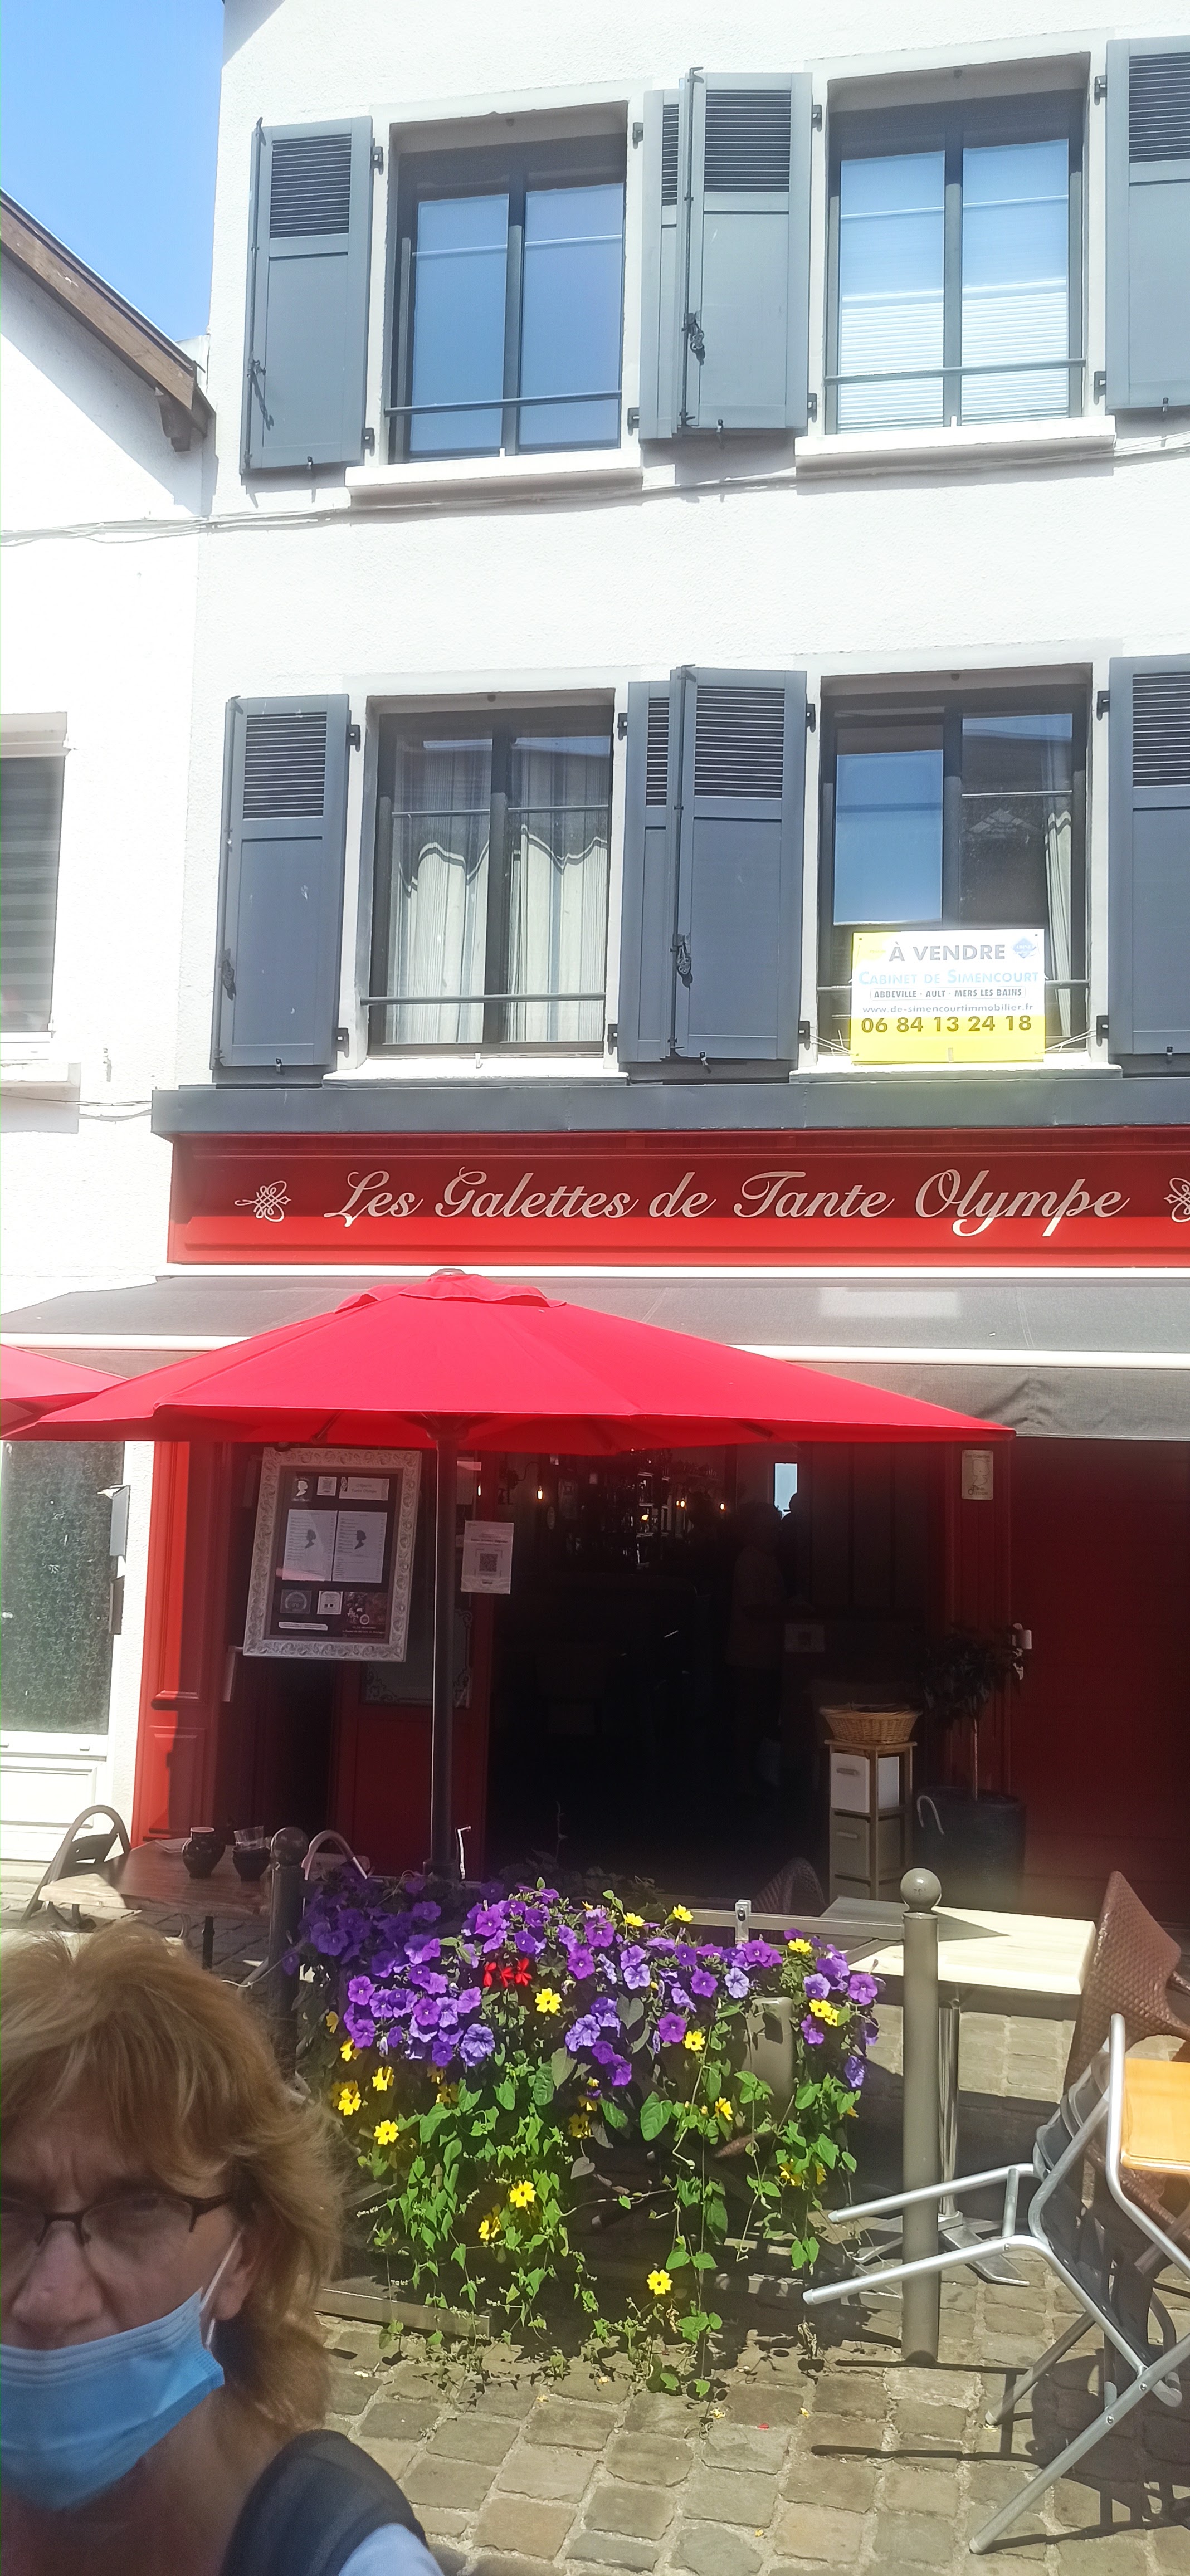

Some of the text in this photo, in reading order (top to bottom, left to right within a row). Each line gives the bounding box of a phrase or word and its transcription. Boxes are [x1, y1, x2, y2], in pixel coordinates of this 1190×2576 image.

[889, 941, 1006, 962] À VENDRE
[859, 969, 1038, 985] CABINET DE SIMENCOURT
[862, 1003, 1033, 1013] www.de-simencourtimmobilier.fr
[861, 1015, 1032, 1033] 06 84 13 24 18
[324, 1167, 1130, 1237] Les Galettes de Tante Olympe
